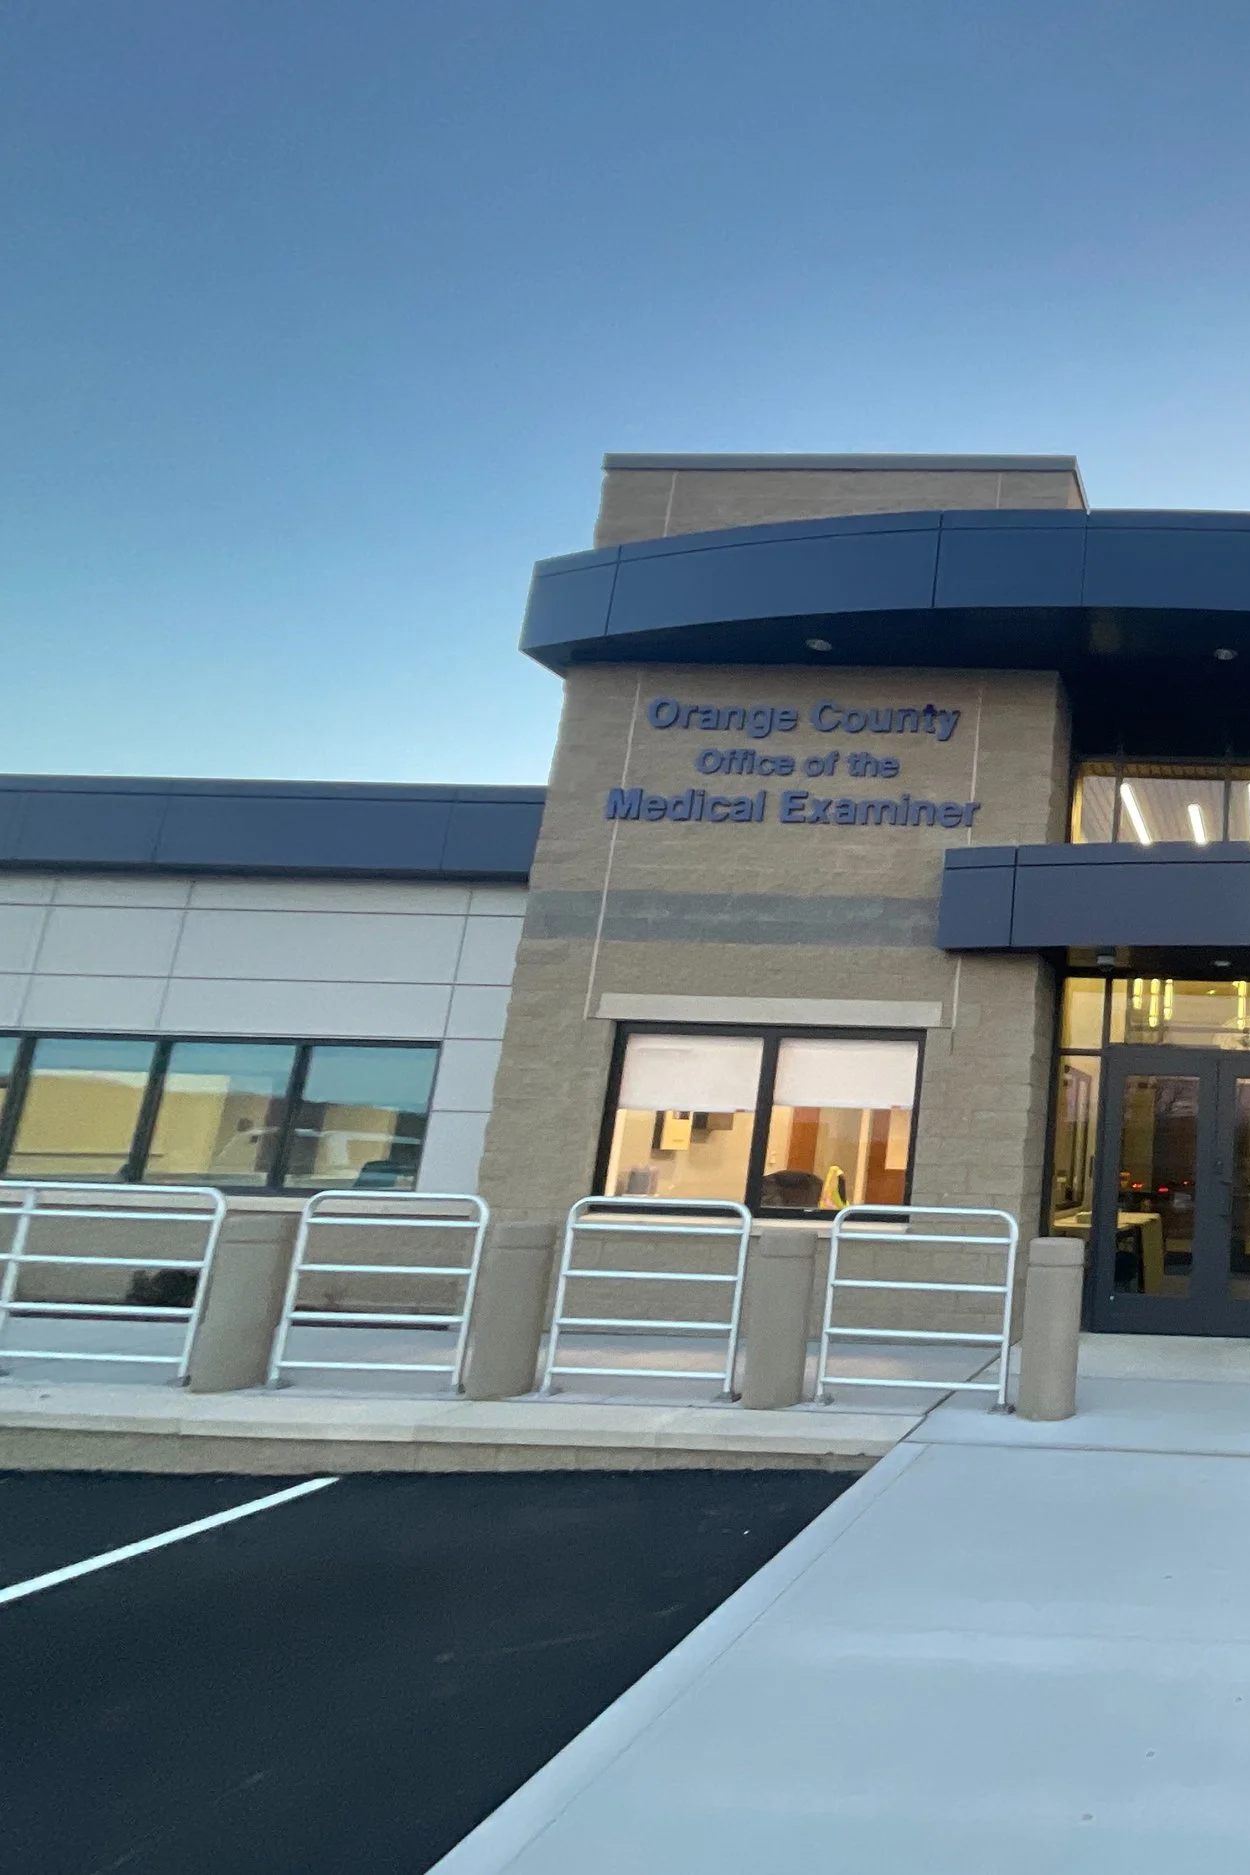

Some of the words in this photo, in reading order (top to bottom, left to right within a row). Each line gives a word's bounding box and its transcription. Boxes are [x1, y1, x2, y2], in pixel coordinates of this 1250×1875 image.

[648, 697, 798, 739] Orange
[809, 700, 961, 741] County
[695, 747, 795, 777] Office
[804, 751, 840, 778] of
[847, 750, 899, 778] the
[605, 787, 767, 823] Medical
[779, 790, 981, 828] Examiner
